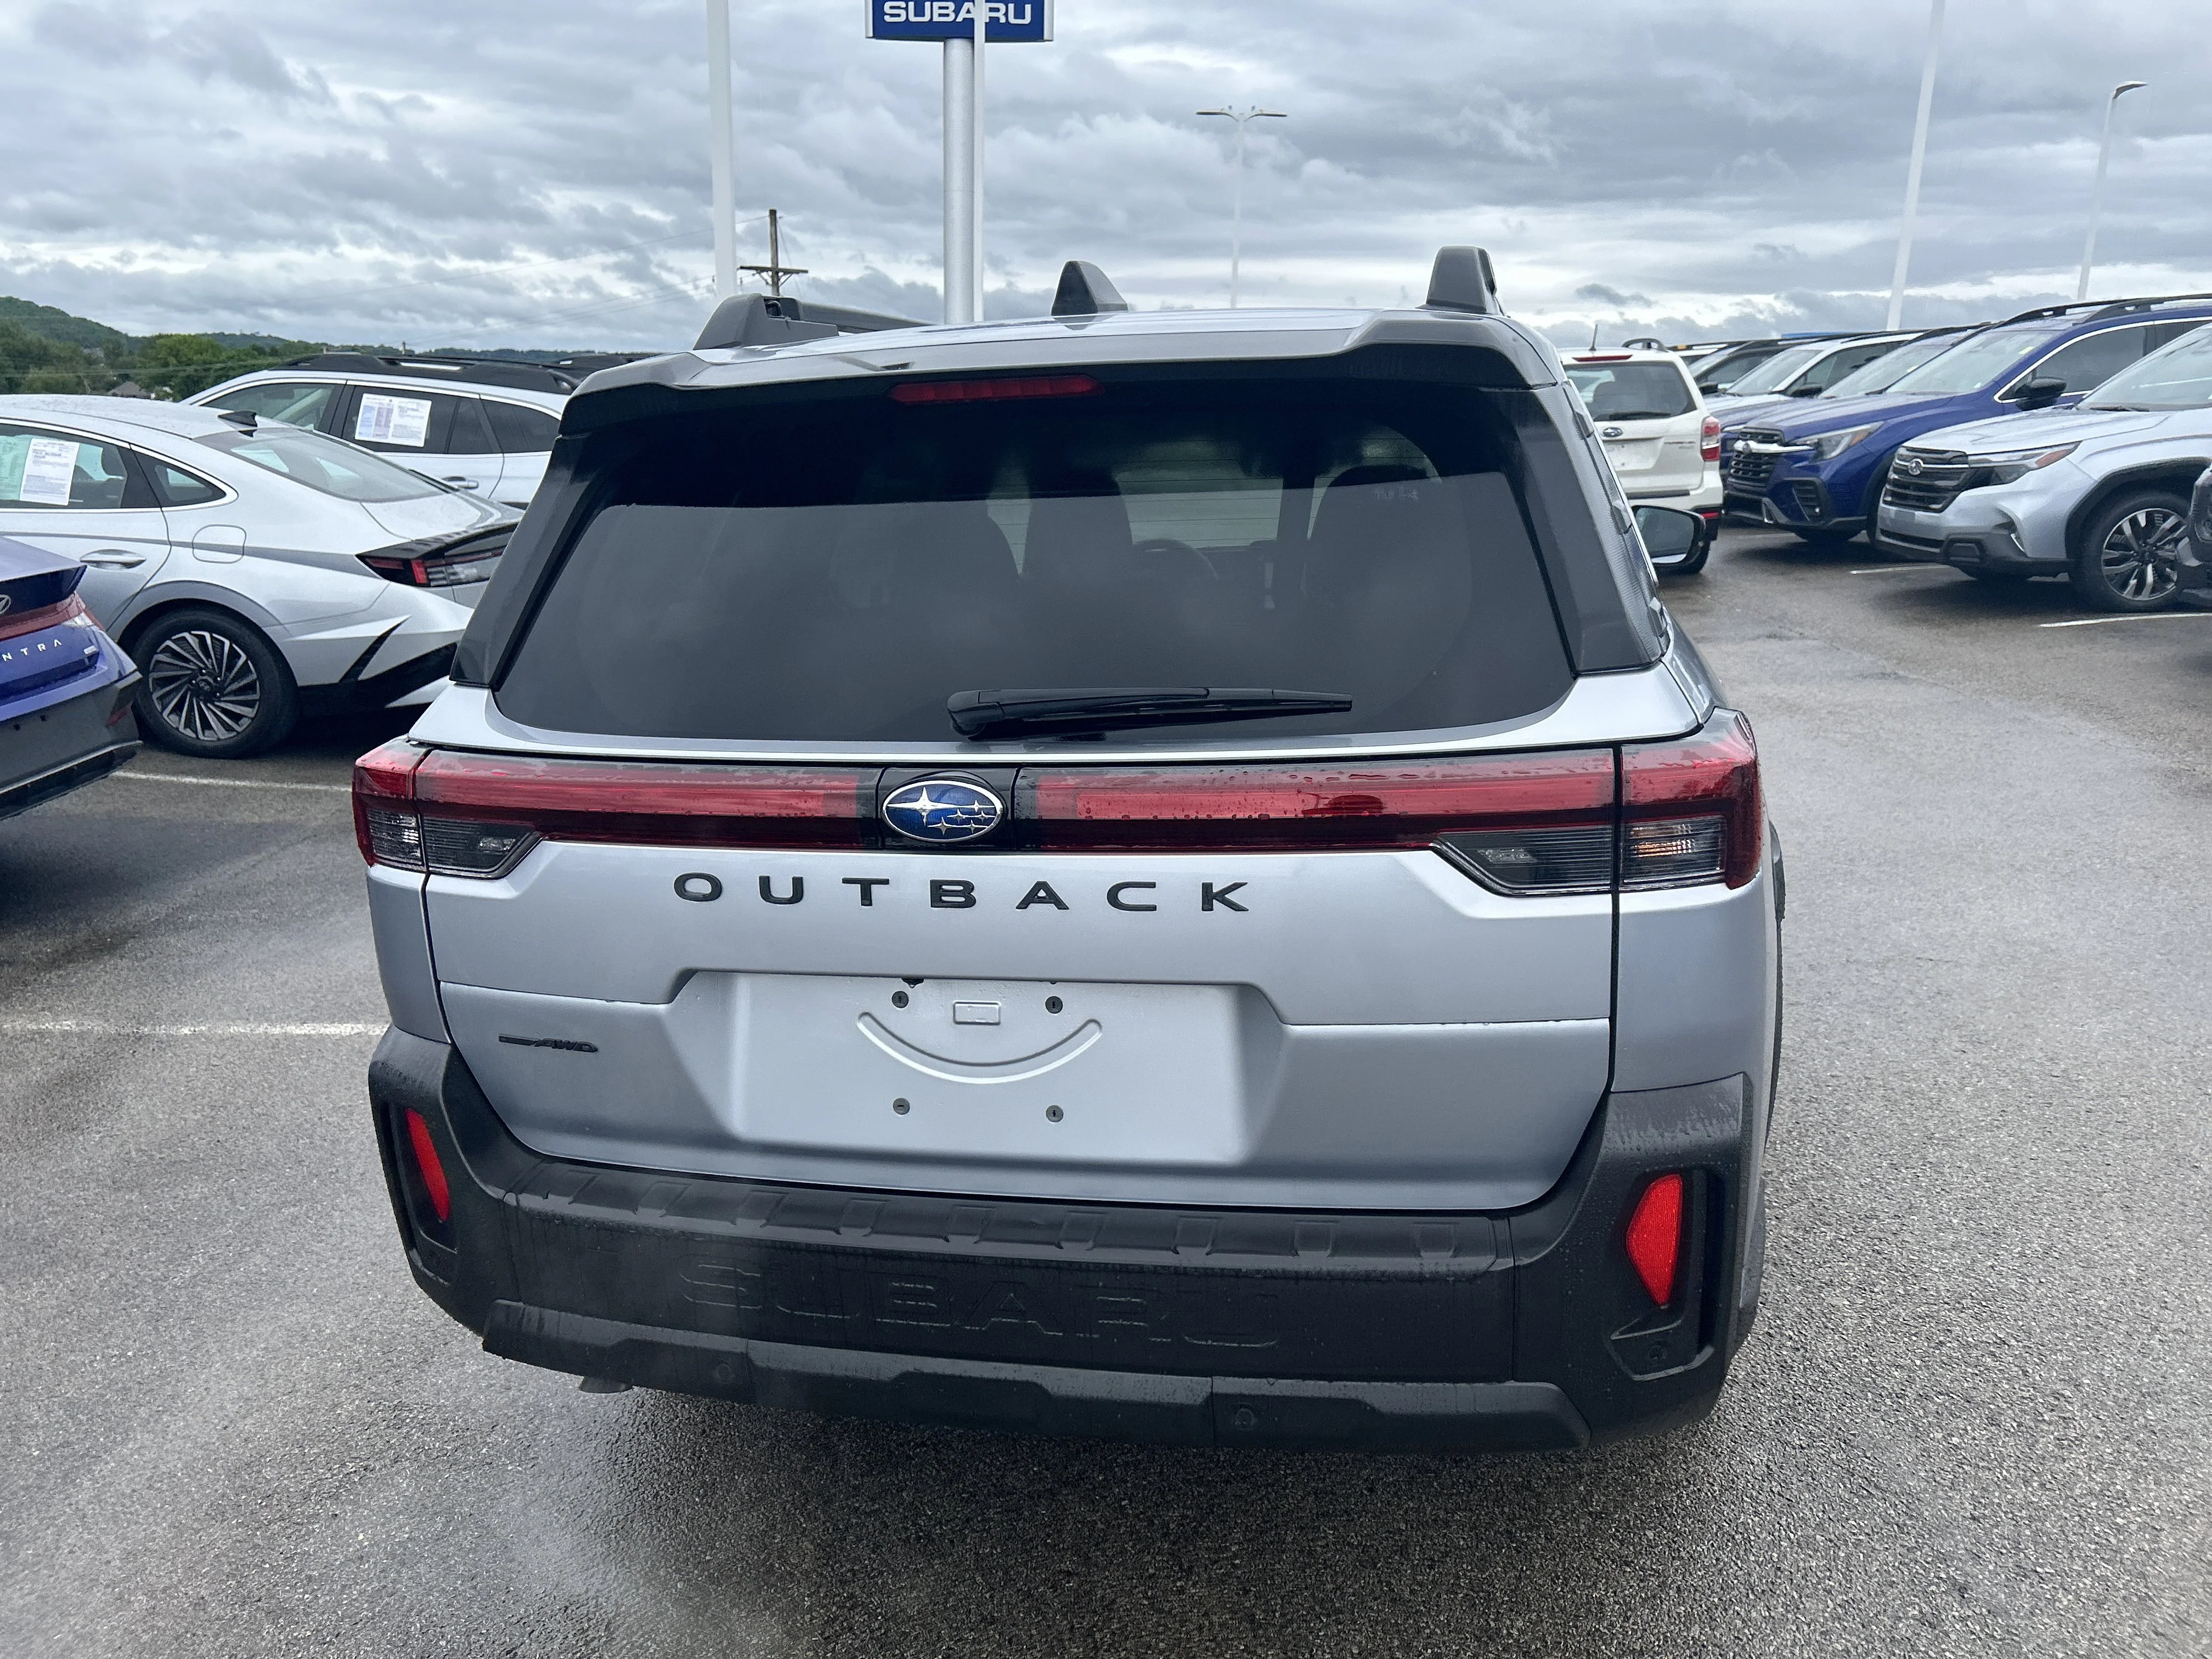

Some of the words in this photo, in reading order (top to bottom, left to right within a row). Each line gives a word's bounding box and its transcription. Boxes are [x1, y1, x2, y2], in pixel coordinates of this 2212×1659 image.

[883, 1, 1032, 25] SUBARU
[673, 872, 1249, 912] OUTBACK
[534, 1038, 599, 1053] AWD
[679, 1254, 1278, 1347] SUBARU
